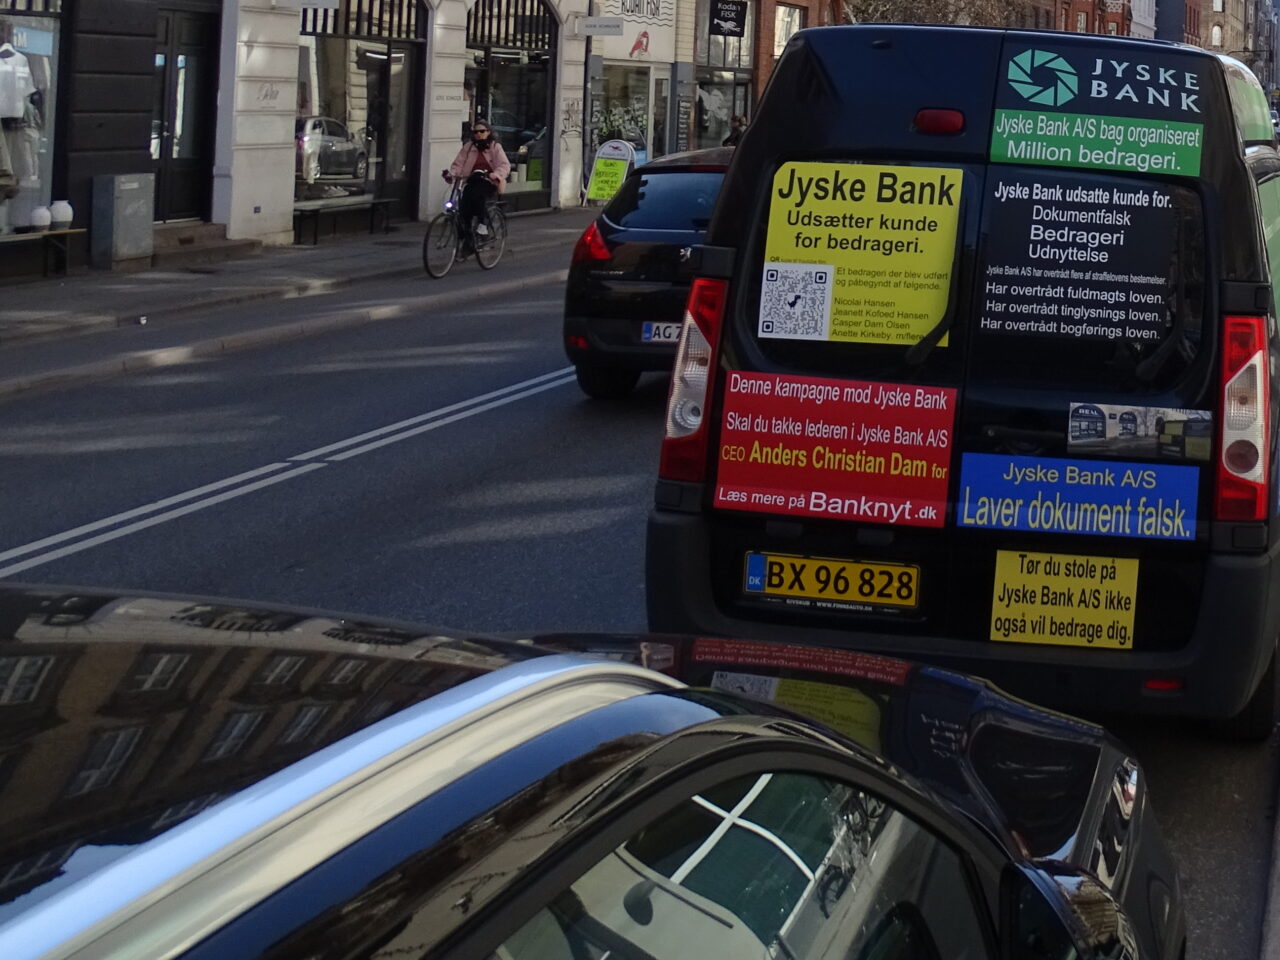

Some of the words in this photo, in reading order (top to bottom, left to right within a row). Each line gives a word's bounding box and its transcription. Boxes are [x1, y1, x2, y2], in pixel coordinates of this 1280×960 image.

[1092, 59, 1199, 90] JYSKE
[1090, 80, 1200, 113] BANK
[997, 113, 1033, 137] Jyske
[1037, 120, 1069, 137] Bank
[1073, 119, 1096, 138] A/S
[1100, 123, 1124, 144] bag
[1128, 126, 1199, 147] organiseret
[1008, 141, 1070, 161] Million
[1079, 145, 1181, 171] bedrageri.
[778, 168, 865, 208] Jyske
[877, 172, 955, 206] Bank
[995, 182, 1029, 202] Jyske
[1032, 184, 1062, 201] Bank
[1066, 187, 1109, 204] udsatte
[1113, 189, 1149, 206] kunde
[1153, 191, 1172, 208] for.
[787, 210, 873, 229] Udsætter
[880, 214, 937, 232] kunde
[1032, 206, 1131, 226] Dokumentfalsk
[795, 233, 821, 248] for
[827, 234, 923, 255] bedrageri.
[1030, 225, 1124, 248] Bedrageri
[1029, 244, 1109, 263] Udnyttelse
[848, 268, 886, 277] bedrageri
[987, 265, 1003, 275] Jyske
[1004, 266, 1019, 275] Bank
[1032, 267, 1042, 276] har
[836, 279, 845, 287] og
[986, 282, 1007, 294] Har
[1010, 284, 1064, 298] overtrådt
[1068, 287, 1126, 303] fuldmagts
[1129, 291, 1165, 304] loven.
[864, 299, 895, 307] Hansen
[986, 300, 1007, 312] Har
[1009, 302, 1058, 316] overtrådt
[1061, 305, 1126, 322] tinglysnings
[1129, 308, 1161, 322] loven.
[886, 321, 910, 329] Olsen
[897, 311, 928, 319] Hansen
[653, 326, 671, 339] AG
[981, 317, 1002, 330] Har
[1005, 319, 1057, 332] overtrådt
[1060, 322, 1122, 339] bogførings
[1126, 326, 1160, 339] loven.
[731, 374, 771, 395] Denne
[775, 378, 839, 404] kampagne
[844, 386, 871, 403] mod
[874, 386, 910, 409] Jyske
[915, 389, 947, 410] Bank
[727, 412, 751, 431] Skal
[754, 415, 768, 432] du
[772, 417, 802, 435] takke
[805, 420, 847, 439] lederen
[851, 423, 855, 440] i
[858, 425, 890, 446] Jyske
[894, 426, 923, 446] Bank
[927, 430, 947, 448] A/S
[722, 445, 745, 461] CEO
[750, 440, 807, 467] Anders
[812, 446, 884, 474] Christian
[891, 453, 927, 477] Dam
[932, 463, 946, 479] for
[1003, 462, 1059, 484] Jyske
[1066, 466, 1115, 486] Bank
[1121, 470, 1156, 489] A/S
[719, 488, 747, 502] Læs
[752, 492, 784, 506] mere
[789, 494, 805, 509] på
[963, 486, 1023, 528] Laver
[1028, 491, 1130, 534] dokument
[1138, 497, 1190, 537] falsk.
[1019, 554, 1040, 575] Tør
[1044, 557, 1060, 577] du
[1065, 559, 1096, 579] stole
[1100, 559, 1116, 584] på
[749, 576, 761, 585] DK
[767, 561, 806, 591] BX
[815, 565, 849, 594] 96
[858, 569, 913, 600] 828
[998, 583, 1036, 607] Jyske
[1041, 586, 1073, 607] Bank
[1078, 588, 1100, 608] A/S
[1105, 590, 1131, 610] ikke
[995, 613, 1026, 637] også
[1031, 615, 1045, 635] vil
[1050, 617, 1103, 644] bedrage
[1107, 621, 1131, 645] dig.
